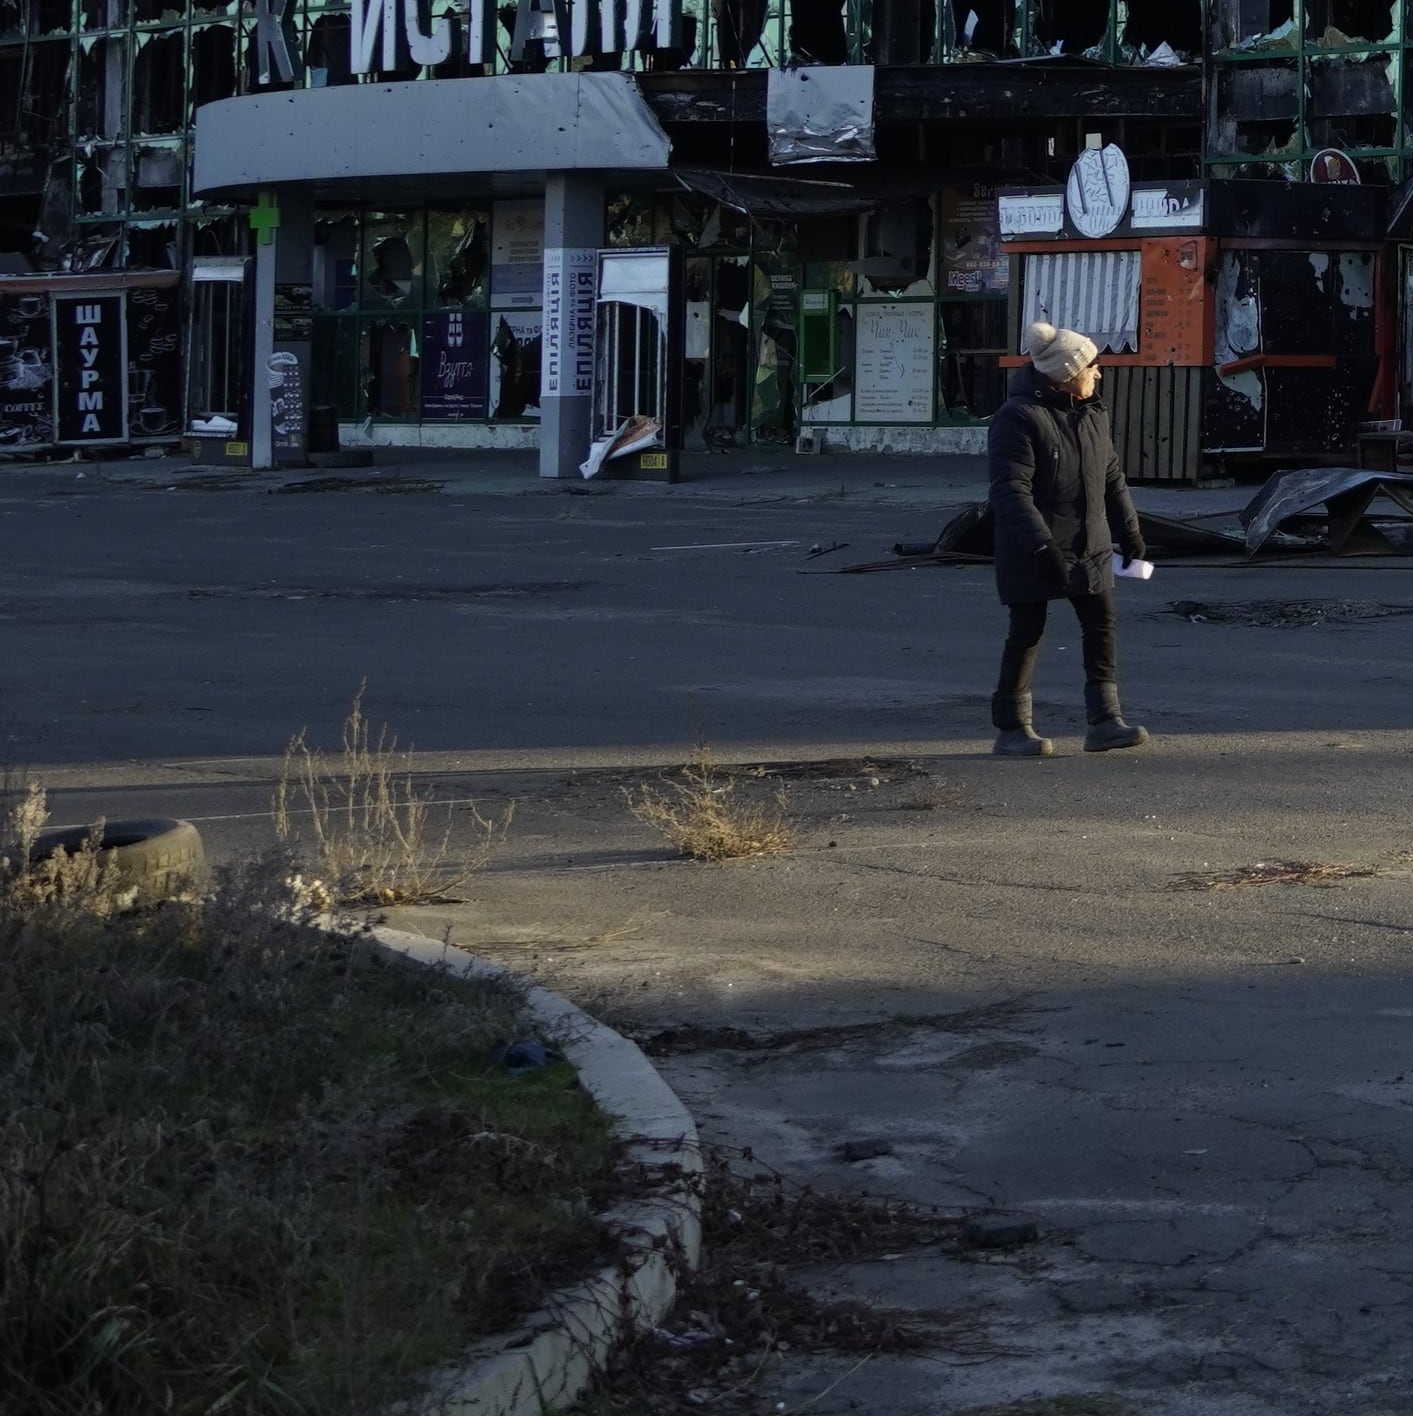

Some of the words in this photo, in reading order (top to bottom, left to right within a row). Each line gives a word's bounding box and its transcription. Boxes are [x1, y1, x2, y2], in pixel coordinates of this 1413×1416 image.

[75, 304, 104, 433] ШАУРМА
[549, 272, 560, 391] ЕПІЛЯЦІЯ
[576, 272, 594, 390] ЕПІЛЯЦІЯ
